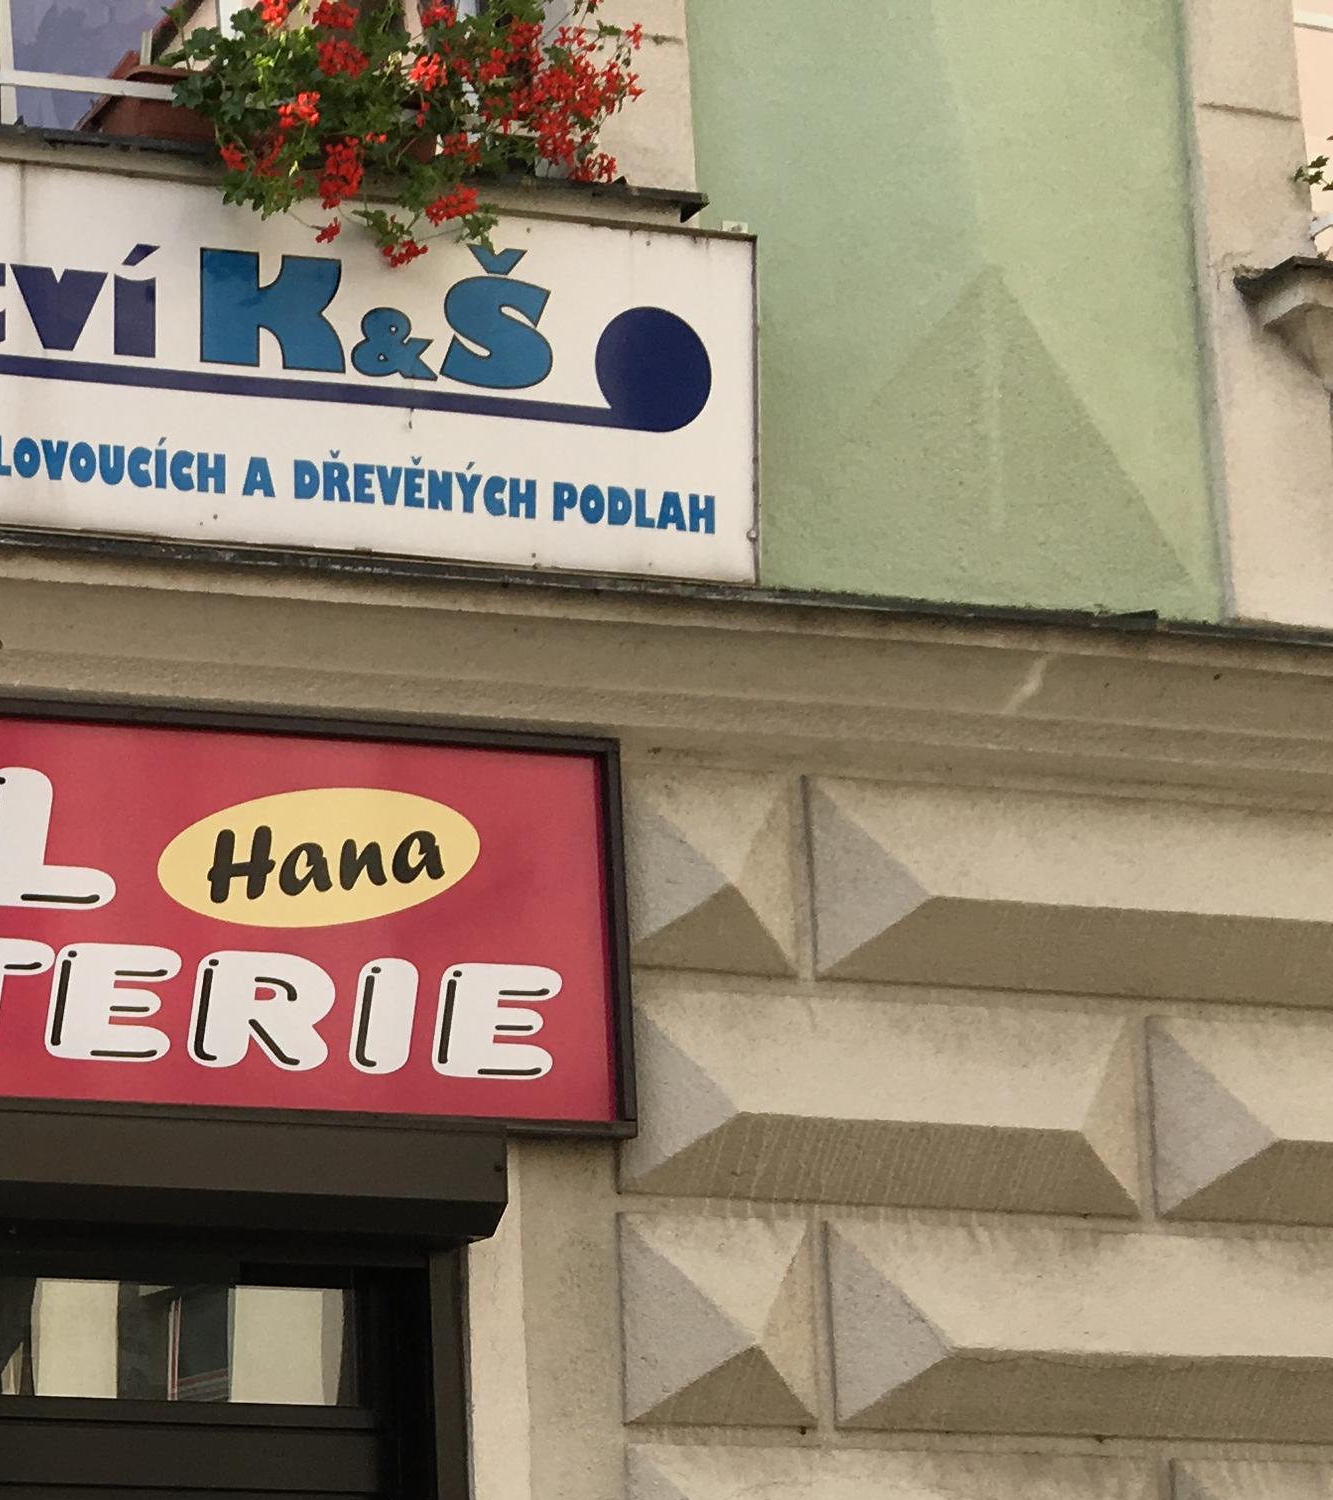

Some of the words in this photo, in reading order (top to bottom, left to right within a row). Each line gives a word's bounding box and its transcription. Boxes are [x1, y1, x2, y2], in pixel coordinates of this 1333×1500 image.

[199, 243, 553, 390] K&Š
[241, 465, 276, 499] A
[293, 449, 537, 521] DŘEVĚNÝCH
[551, 480, 717, 536] PODLAH
[207, 825, 446, 904] Hana
